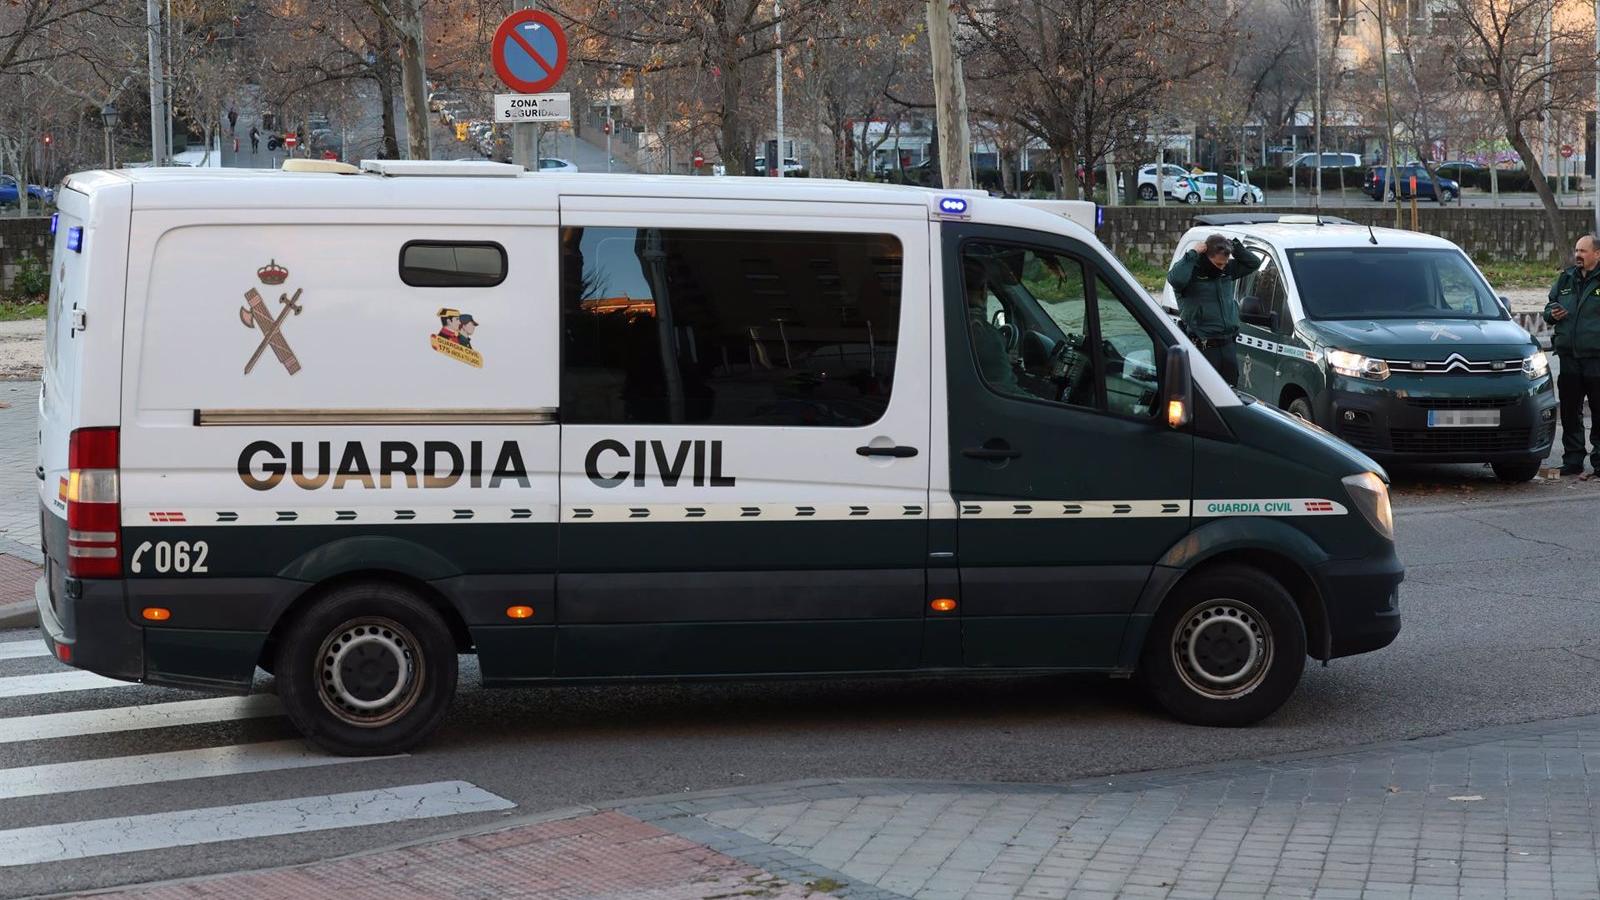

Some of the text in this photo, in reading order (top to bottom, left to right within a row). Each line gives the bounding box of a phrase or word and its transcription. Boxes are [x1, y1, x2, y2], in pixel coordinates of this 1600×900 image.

[511, 99, 538, 107] ZONA
[237, 439, 736, 491] GUARDIA CIVIL
[1207, 502, 1292, 513] GUARDIA CIVIL
[155, 540, 209, 573] 062
